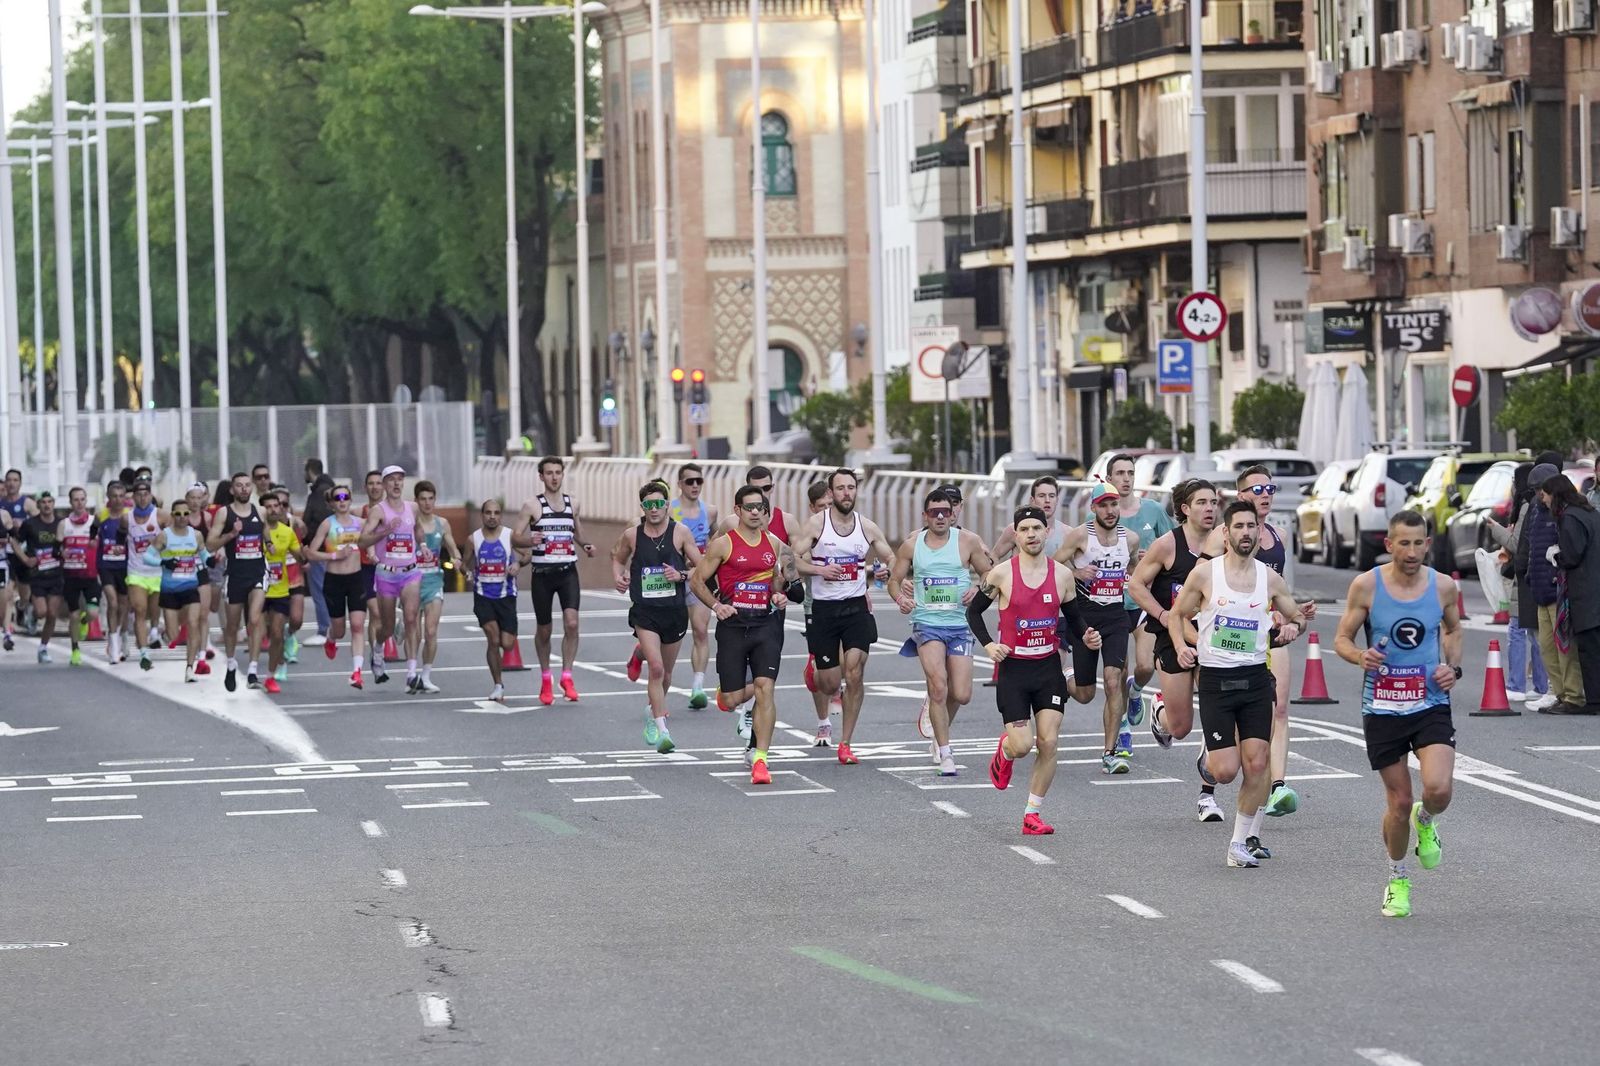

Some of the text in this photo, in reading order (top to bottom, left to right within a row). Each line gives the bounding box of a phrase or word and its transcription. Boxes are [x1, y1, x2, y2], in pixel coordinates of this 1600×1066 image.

[1384, 312, 1440, 329] TINTE
[1399, 326, 1434, 352] 5€
[1162, 344, 1185, 374] P
[1030, 619, 1053, 627] ZURICH
[1229, 620, 1255, 629] ZURICH
[1027, 637, 1046, 647] MATI
[1221, 639, 1246, 650] BRICE
[1391, 667, 1420, 675] ZURICH
[1393, 681, 1406, 689] 665
[1376, 689, 1424, 700] RIVEMALE
